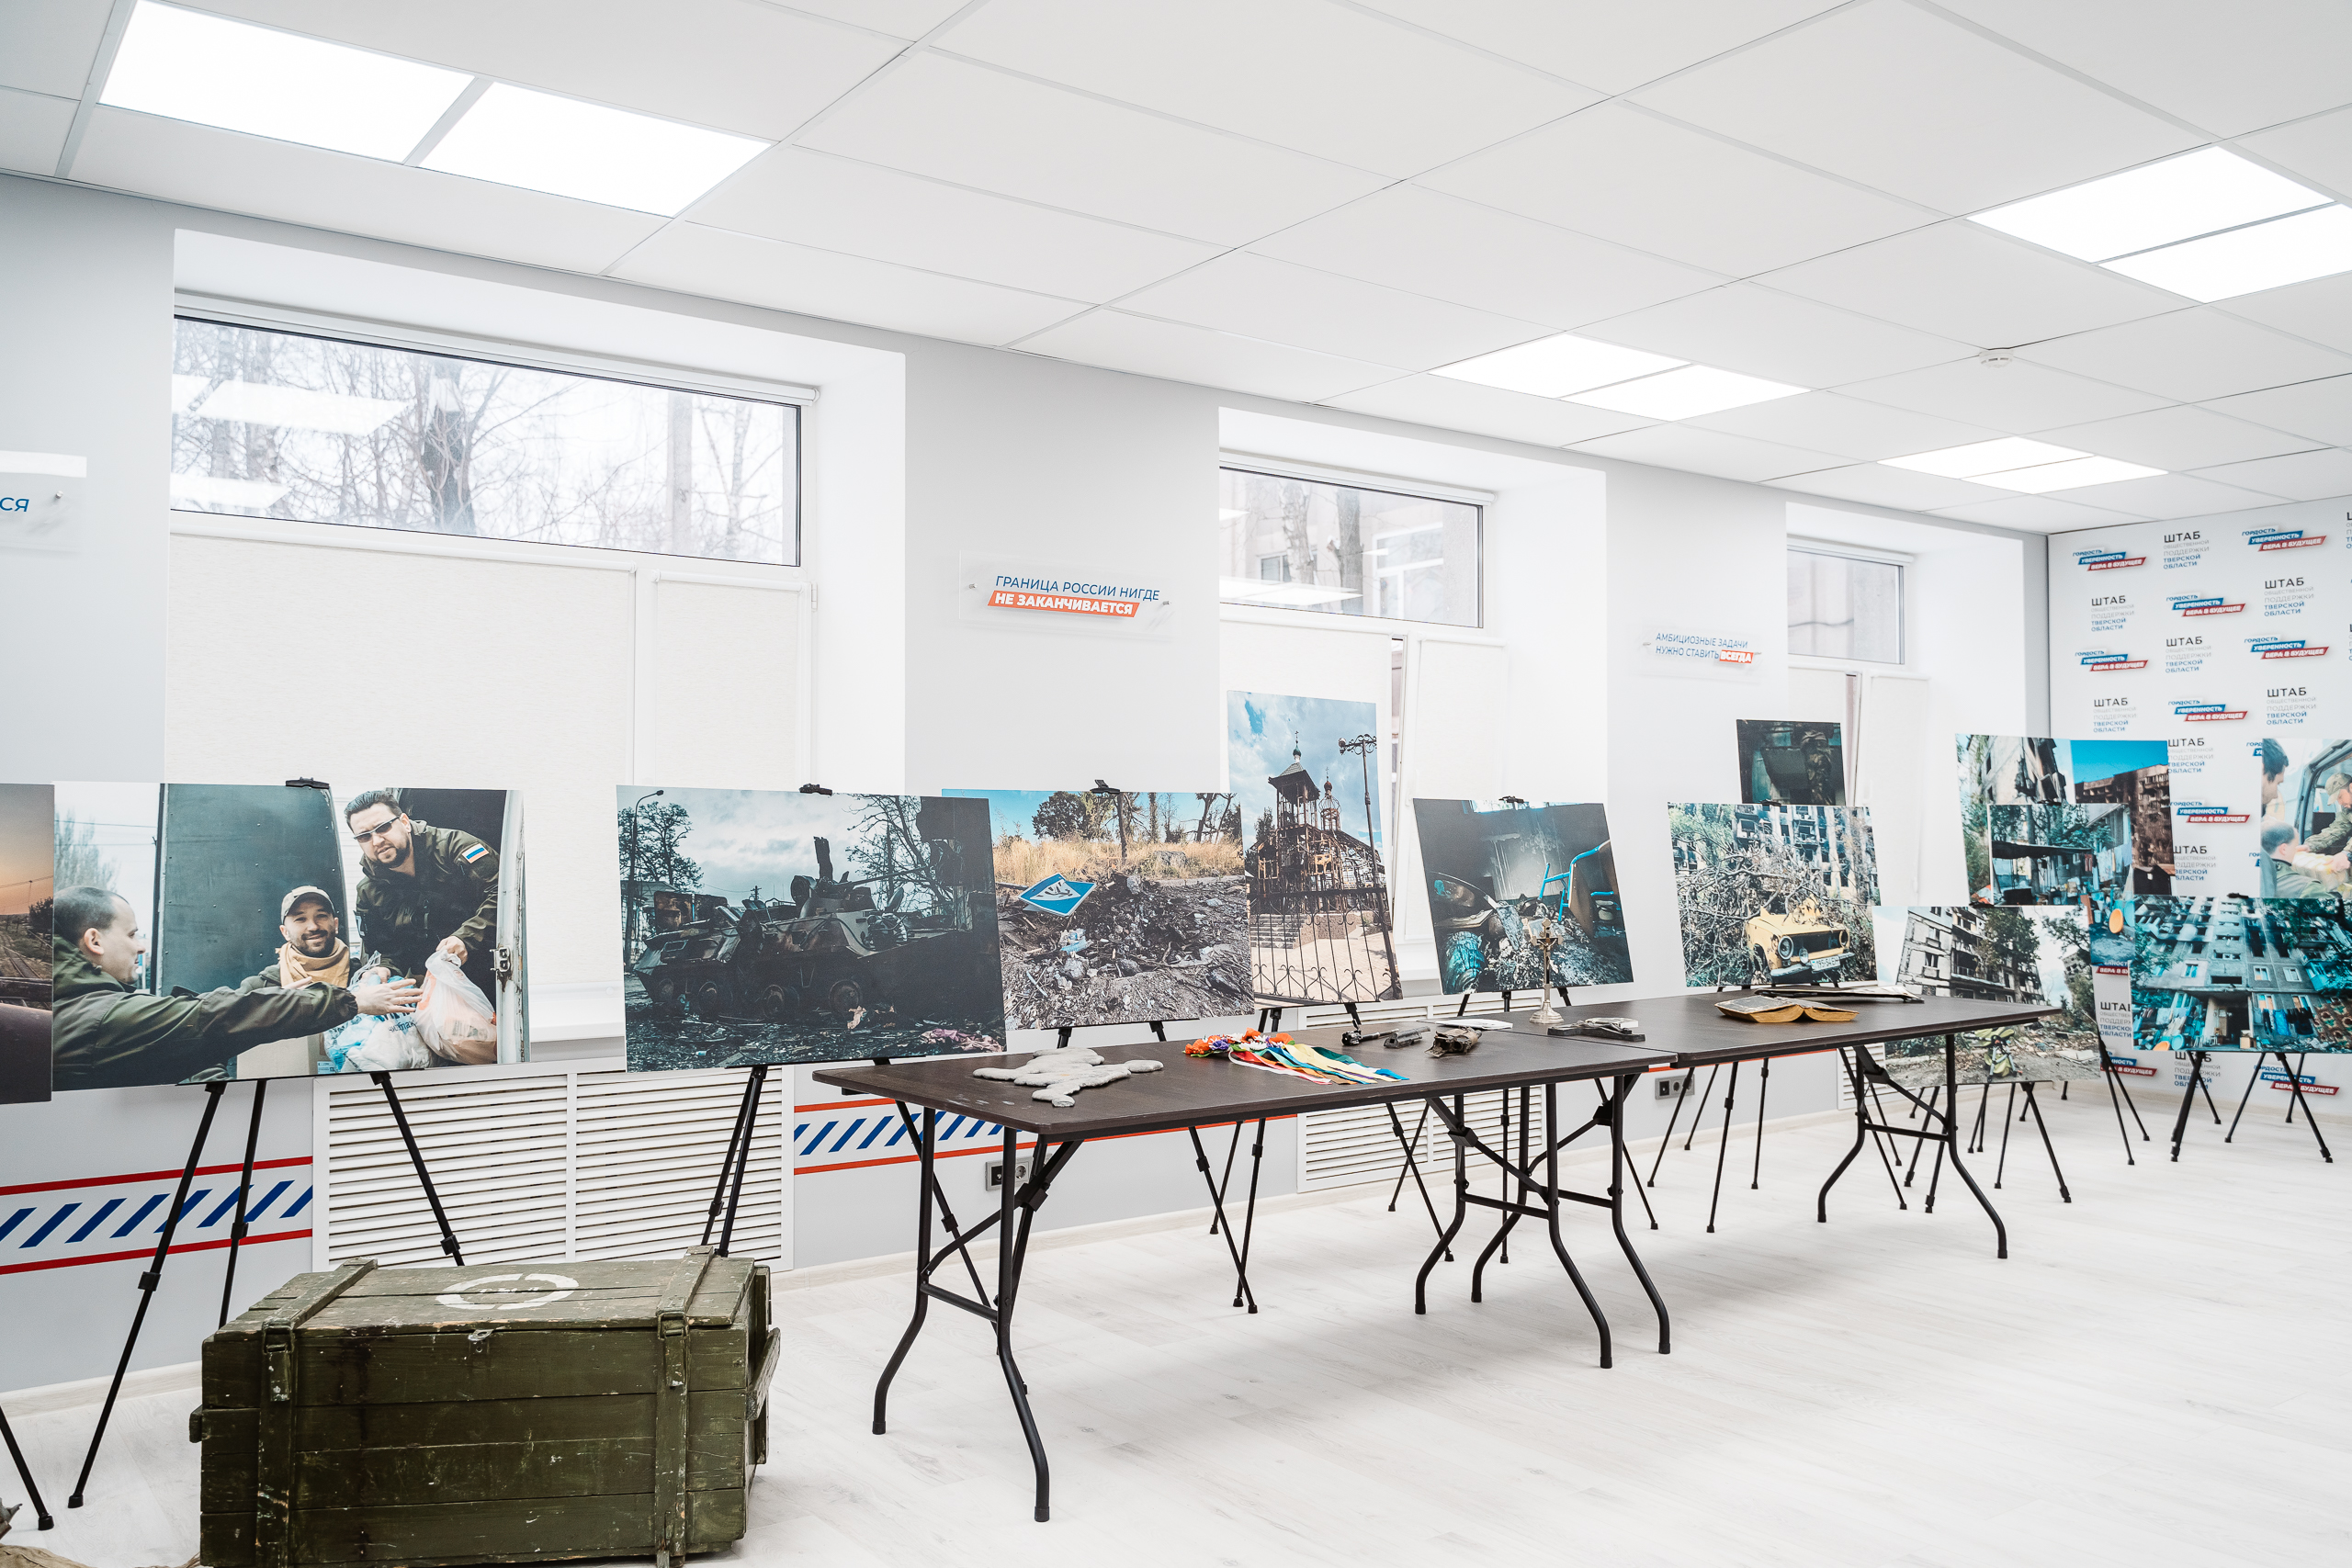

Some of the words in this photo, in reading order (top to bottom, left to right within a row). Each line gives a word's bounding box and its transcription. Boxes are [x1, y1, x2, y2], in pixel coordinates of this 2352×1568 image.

[2242, 528, 2276, 536] ГОРДОСТЬ
[2164, 531, 2200, 543] ШТАБ
[2251, 534, 2300, 543] УВЕРЕННОСТЬ
[2288, 537, 2322, 547] БУДУЩЕЕ
[2080, 554, 2123, 563] УВЕРЕННОСТЬ
[2113, 558, 2143, 567] БУДУЩЕЕ
[2164, 554, 2200, 562] ТВЕРСКОЙ
[2164, 561, 2197, 570] ОБЛАСТИ
[2265, 577, 2304, 589] ШТАБ
[996, 575, 1058, 592] ГРАНИЦА
[1062, 581, 1115, 597] РОССИИ
[1120, 588, 1160, 602] НИГДЕ
[995, 592, 1014, 605] НЕ
[1017, 594, 1134, 615] ЗАКАНЧИВАЕТСЯ
[2091, 595, 2126, 606] ШТАБ
[2175, 600, 2221, 608] УВЕРЕННОСТЬ
[2210, 605, 2242, 614] БУДУЩЕЕ
[2264, 601, 2304, 610] ТВЕРСКОЙ
[2264, 608, 2301, 616] ОБЛАСТИ
[2091, 617, 2126, 626] ТВЕРСКОЙ
[1656, 632, 1716, 647] АМБИЦИОЗНЫЕ
[1718, 637, 1748, 649] ЗАДАЧИ
[2165, 636, 2202, 647] ШТАБ
[2254, 643, 2302, 651] УВЕРЕННОСТЬ
[1656, 645, 1684, 656] НУЖНО
[1686, 648, 1720, 660] СТАВИТЬ
[1720, 650, 1751, 662] ВСЕГДА
[2290, 648, 2324, 657] БУДУЩЕЕ
[2083, 656, 2125, 664] УВЕРЕННОСТЬ
[2165, 659, 2202, 667] ТВЕРСКОЙ
[2115, 661, 2144, 670] БУДУЩЕЕ
[2267, 686, 2307, 697] ШТАБ
[2094, 697, 2128, 707] ШТАБ
[2168, 738, 2204, 747] ШТАБ
[2173, 845, 2207, 854] ШТАБ
[2123, 1066, 2153, 1075] БУДУЩЕЕ
